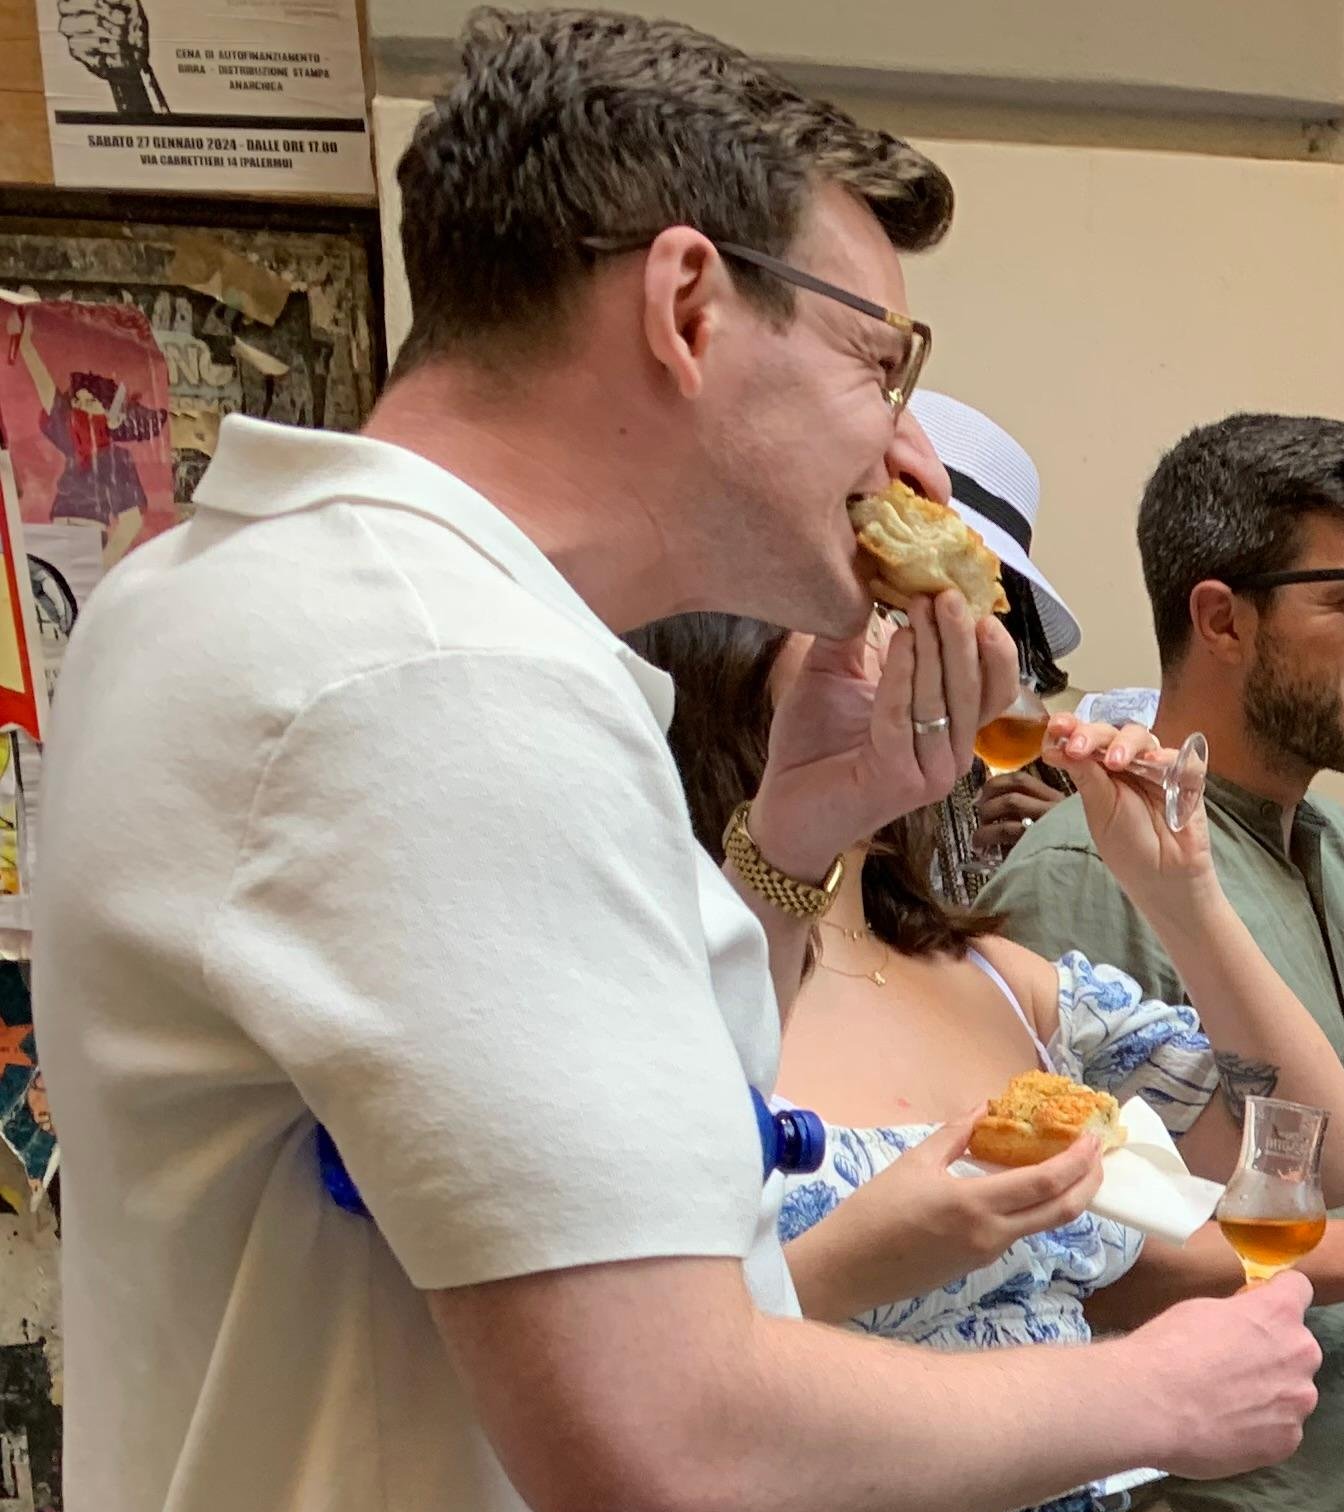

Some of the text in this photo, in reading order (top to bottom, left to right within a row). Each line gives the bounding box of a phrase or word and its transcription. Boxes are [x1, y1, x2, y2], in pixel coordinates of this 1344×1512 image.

[218, 50, 320, 63] AUTOFINANZIAMENTO
[292, 67, 330, 79] STAMPA
[87, 135, 134, 148] SABATO
[136, 136, 149, 149] 27
[152, 136, 203, 150] GENNAIO
[206, 137, 237, 151] 2024
[246, 139, 279, 152] DALLE
[282, 140, 305, 153] ORE
[140, 154, 158, 165] VIA
[226, 156, 238, 168] 14
